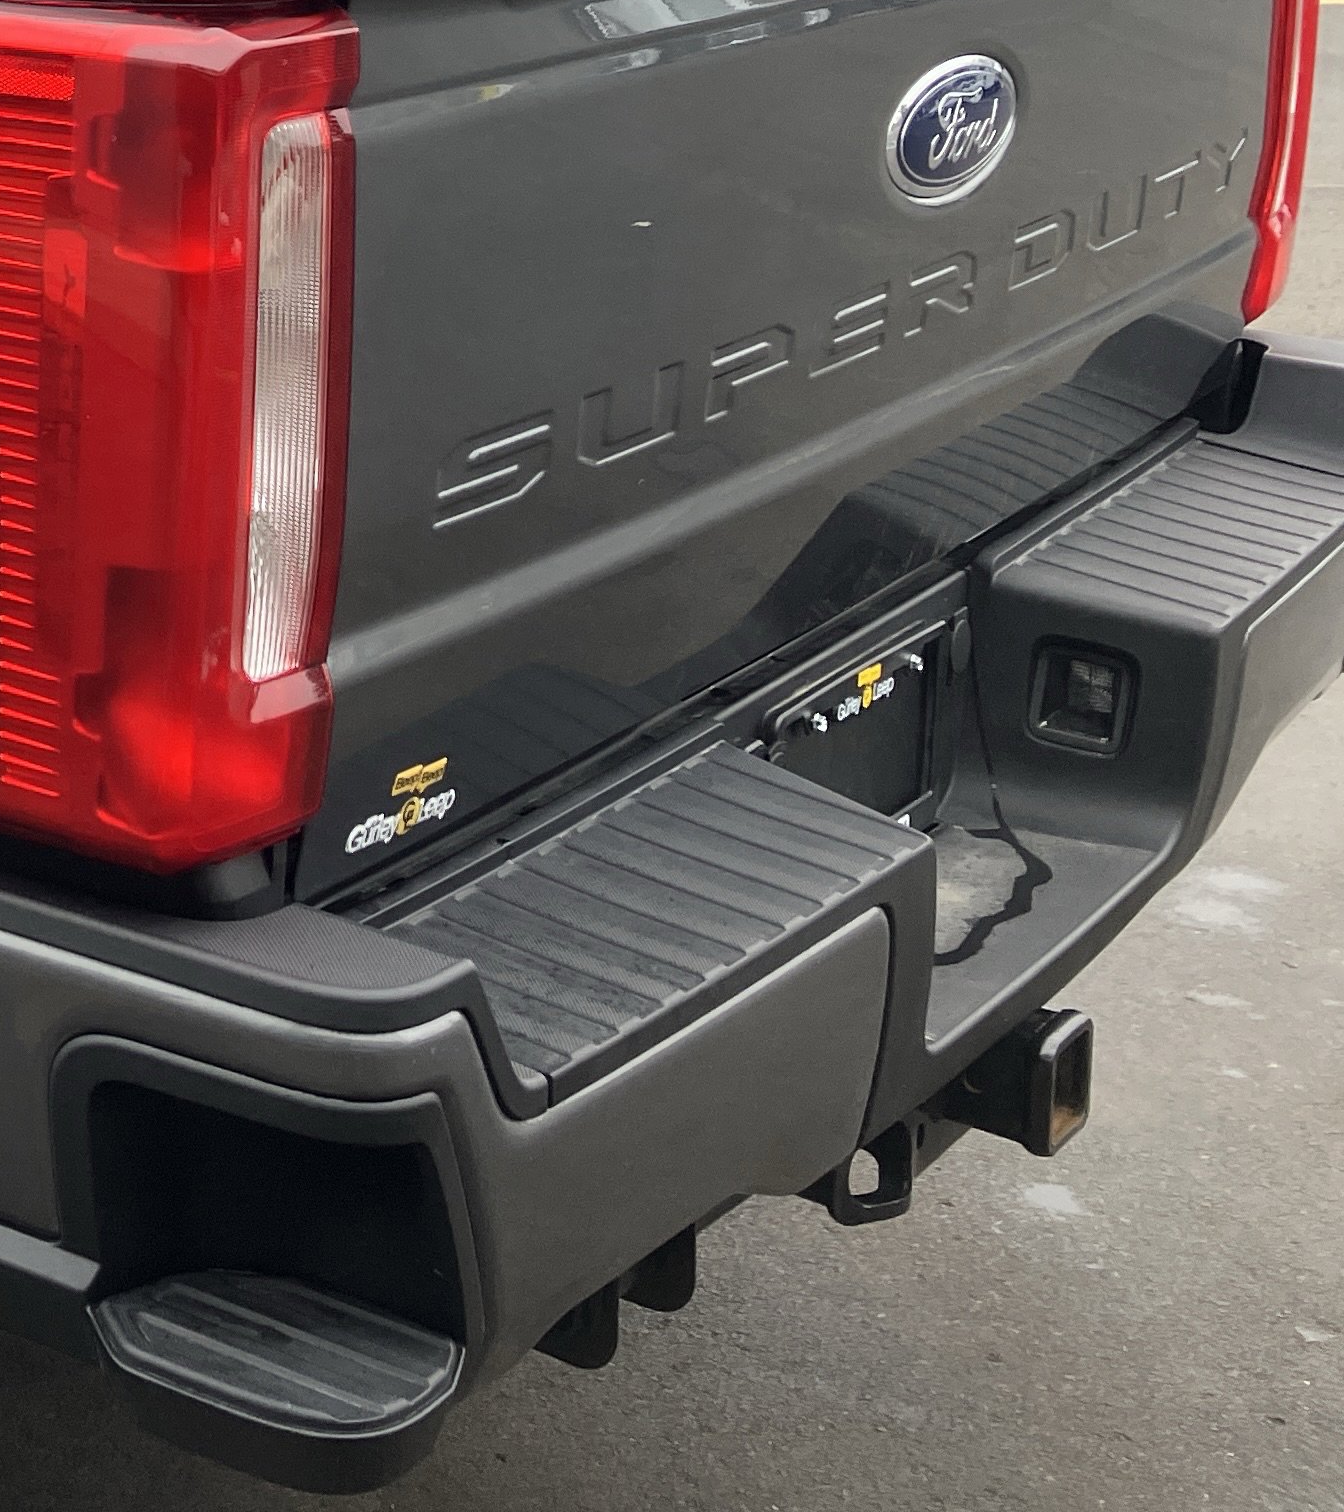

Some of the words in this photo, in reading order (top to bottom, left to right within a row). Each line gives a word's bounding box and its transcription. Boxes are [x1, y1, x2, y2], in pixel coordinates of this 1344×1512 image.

[927, 86, 999, 170] Ford
[432, 249, 980, 530] SUPER
[1009, 125, 1250, 292] DUTY
